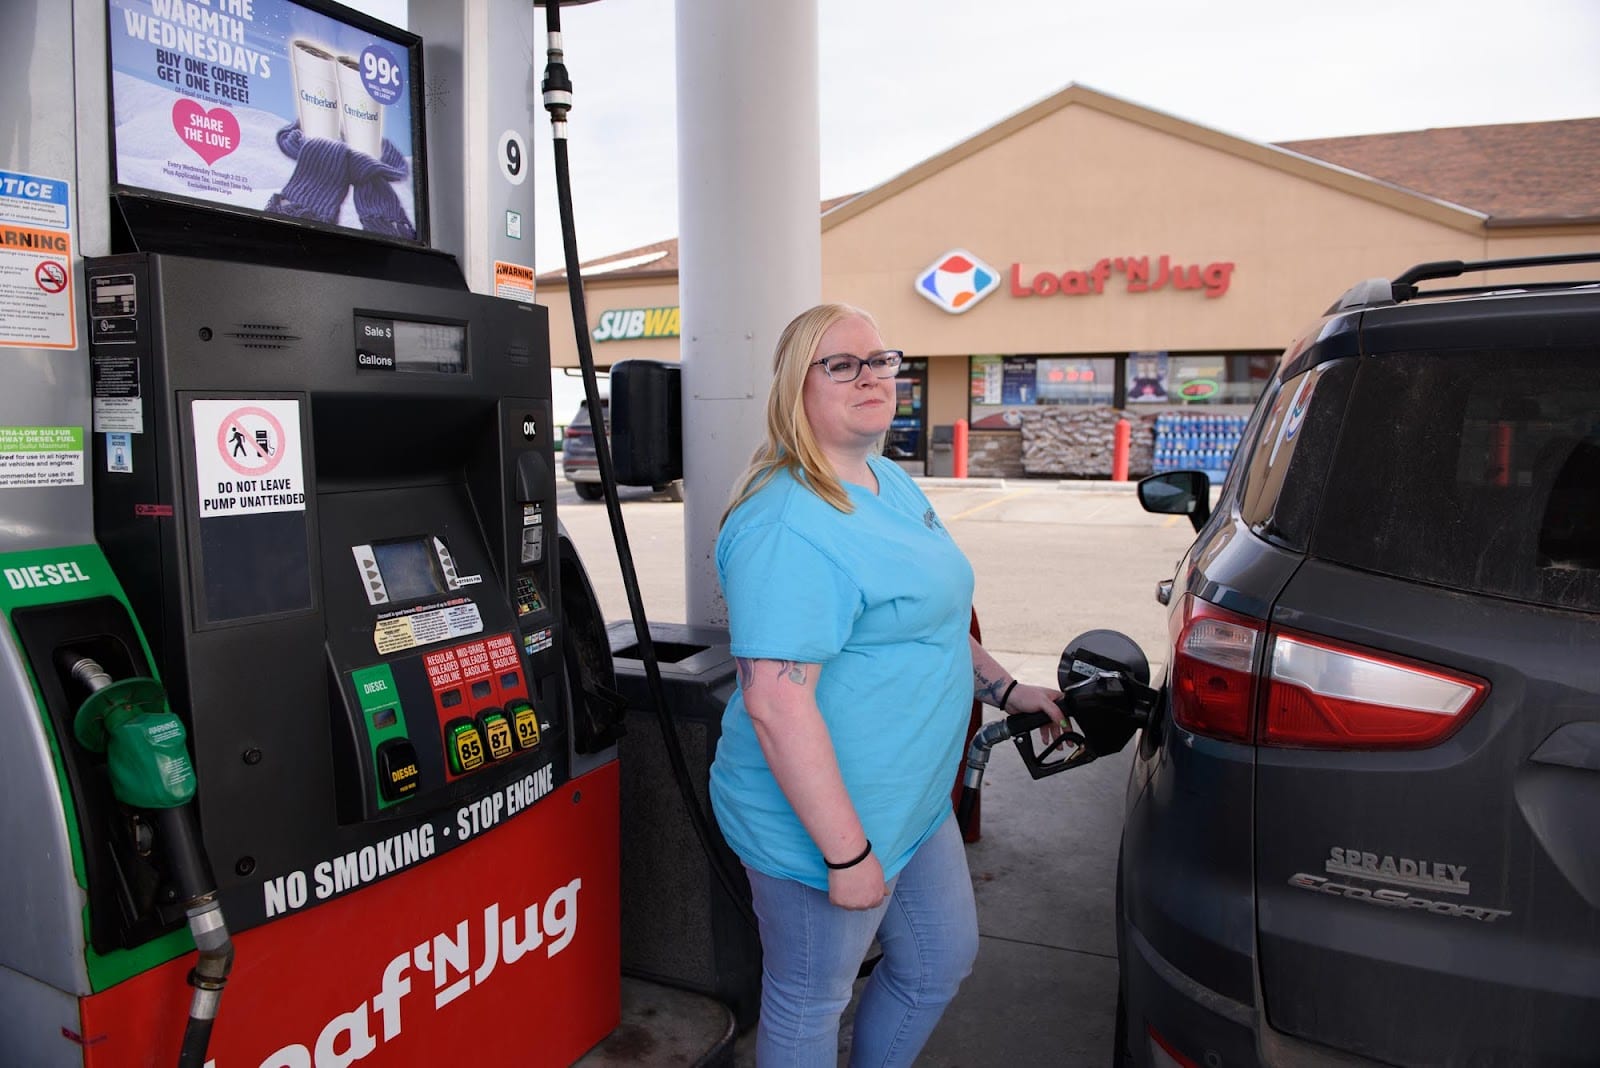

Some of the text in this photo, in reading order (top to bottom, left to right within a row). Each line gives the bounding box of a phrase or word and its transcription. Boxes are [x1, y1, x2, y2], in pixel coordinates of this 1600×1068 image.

[152, 0, 244, 44] WARMTH
[124, 8, 271, 78] WEDNESDAYS
[156, 48, 249, 89] BUY ONE COFFEE
[364, 52, 400, 87] 99¢
[157, 65, 249, 104] GET ONE FREE!
[190, 113, 223, 133] SHARE
[184, 126, 231, 149] THE LOVE
[506, 139, 521, 176] 9
[0, 178, 54, 199] TICE
[0, 230, 66, 251] RNING
[502, 264, 533, 281] WARNING
[1010, 257, 1111, 298] Loaf
[1151, 255, 1235, 299] Jug
[364, 325, 392, 339] Sale $
[592, 307, 680, 341] SUBWA
[359, 353, 393, 366] Gallons
[523, 421, 536, 436] OK
[56, 453, 80, 461] highway
[218, 479, 291, 494] DO NOT LEAVE
[204, 493, 305, 511] PUMP UNATTENDED
[3, 561, 90, 590] DIESEL
[456, 642, 486, 658] MID-GRADE
[487, 636, 512, 650] PREMIUM
[426, 651, 455, 666] REGULAR
[459, 652, 488, 668] UNLEADED
[489, 645, 517, 660] UNLEADED
[492, 654, 518, 669] GASOLINE
[428, 660, 459, 677] UNLEADED
[463, 662, 490, 678] GASOLINE
[363, 679, 388, 695] DIESEL
[432, 670, 461, 687] GASOLINE
[519, 720, 536, 738] 91
[491, 730, 507, 749] 87
[461, 740, 480, 760] 85
[392, 764, 418, 782] DIESEL
[263, 763, 554, 918] NO SMOKING STOP ENGINE
[1329, 846, 1468, 884] SPRADLEY
[203, 952, 411, 1068] af
[474, 878, 582, 986] Jug
